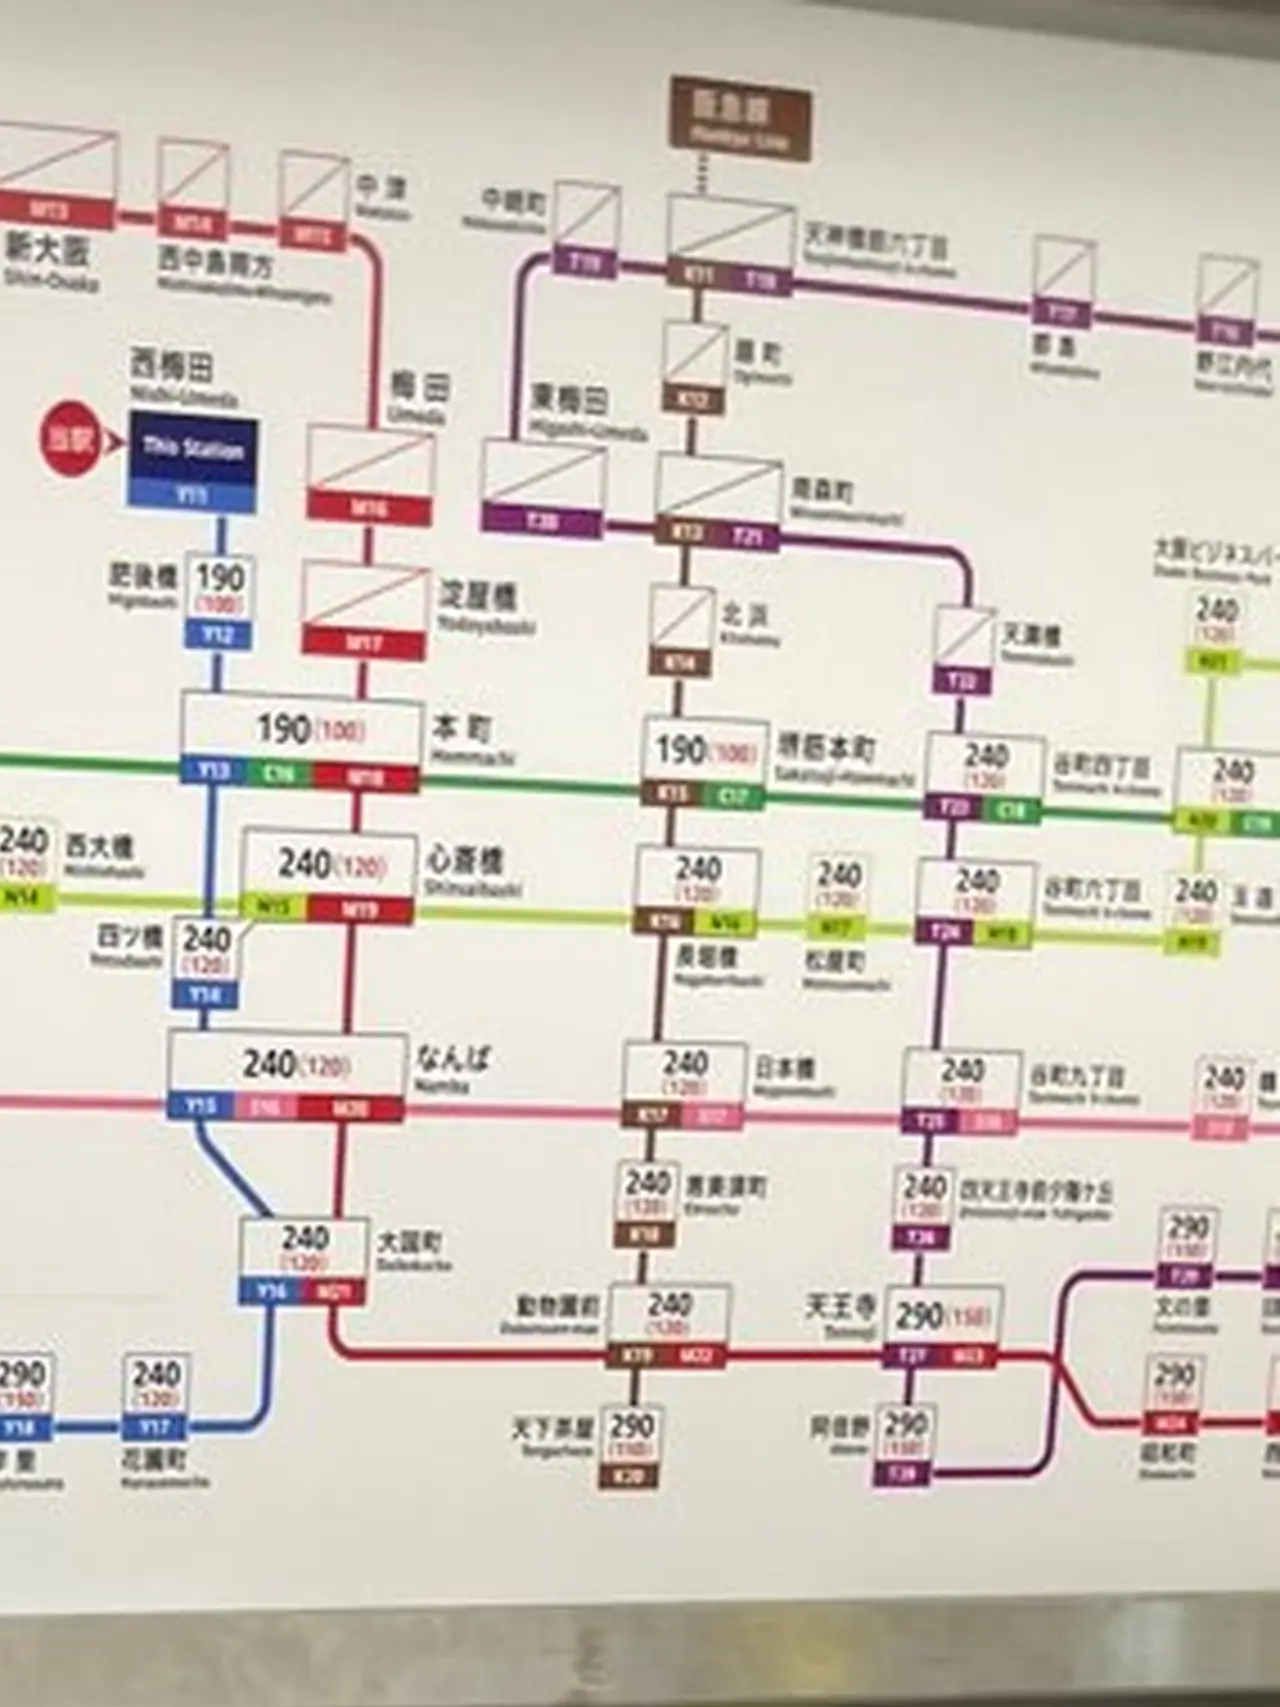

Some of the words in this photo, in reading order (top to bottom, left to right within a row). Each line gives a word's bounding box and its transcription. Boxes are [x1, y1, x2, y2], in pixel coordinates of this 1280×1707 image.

[196, 564, 244, 592] 190
[1197, 597, 1240, 623] 240
[964, 743, 1009, 769] 240
[675, 856, 722, 882] 240
[818, 861, 862, 889] 240
[183, 926, 232, 954] 240
[415, 1045, 490, 1074] なんば
[663, 1049, 710, 1077] 240
[1203, 1064, 1246, 1092] 240
[282, 1225, 330, 1252] 240
[1166, 1213, 1209, 1240] 290
[132, 1360, 181, 1388] 240
[1153, 1361, 1196, 1388] 290
[608, 1413, 655, 1441] 290
[884, 1412, 927, 1438] 290
